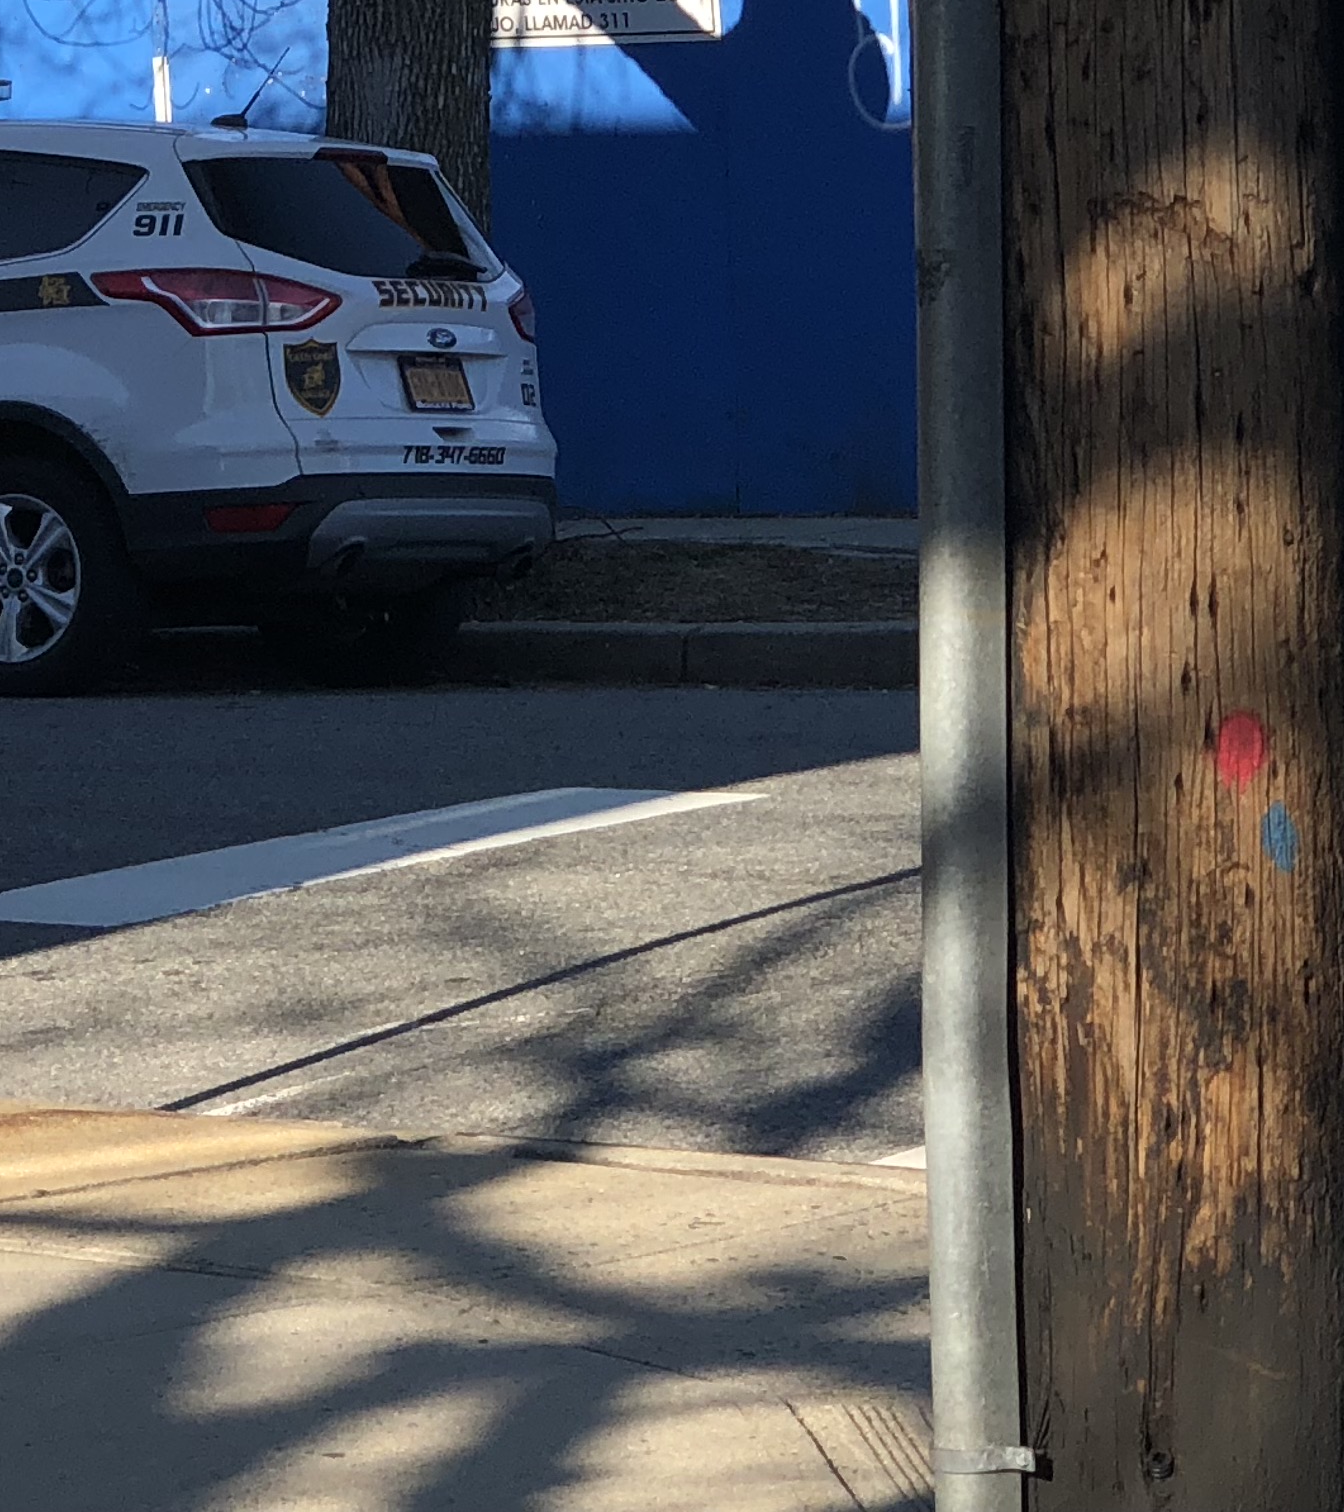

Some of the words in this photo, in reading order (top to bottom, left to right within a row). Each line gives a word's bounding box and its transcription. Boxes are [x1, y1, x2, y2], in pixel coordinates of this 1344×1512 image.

[525, 14, 592, 32] LLAMAD
[600, 13, 630, 29] 311
[133, 214, 184, 236] 911
[372, 280, 487, 312] SECURITY
[402, 445, 506, 465] 718-347-6660
